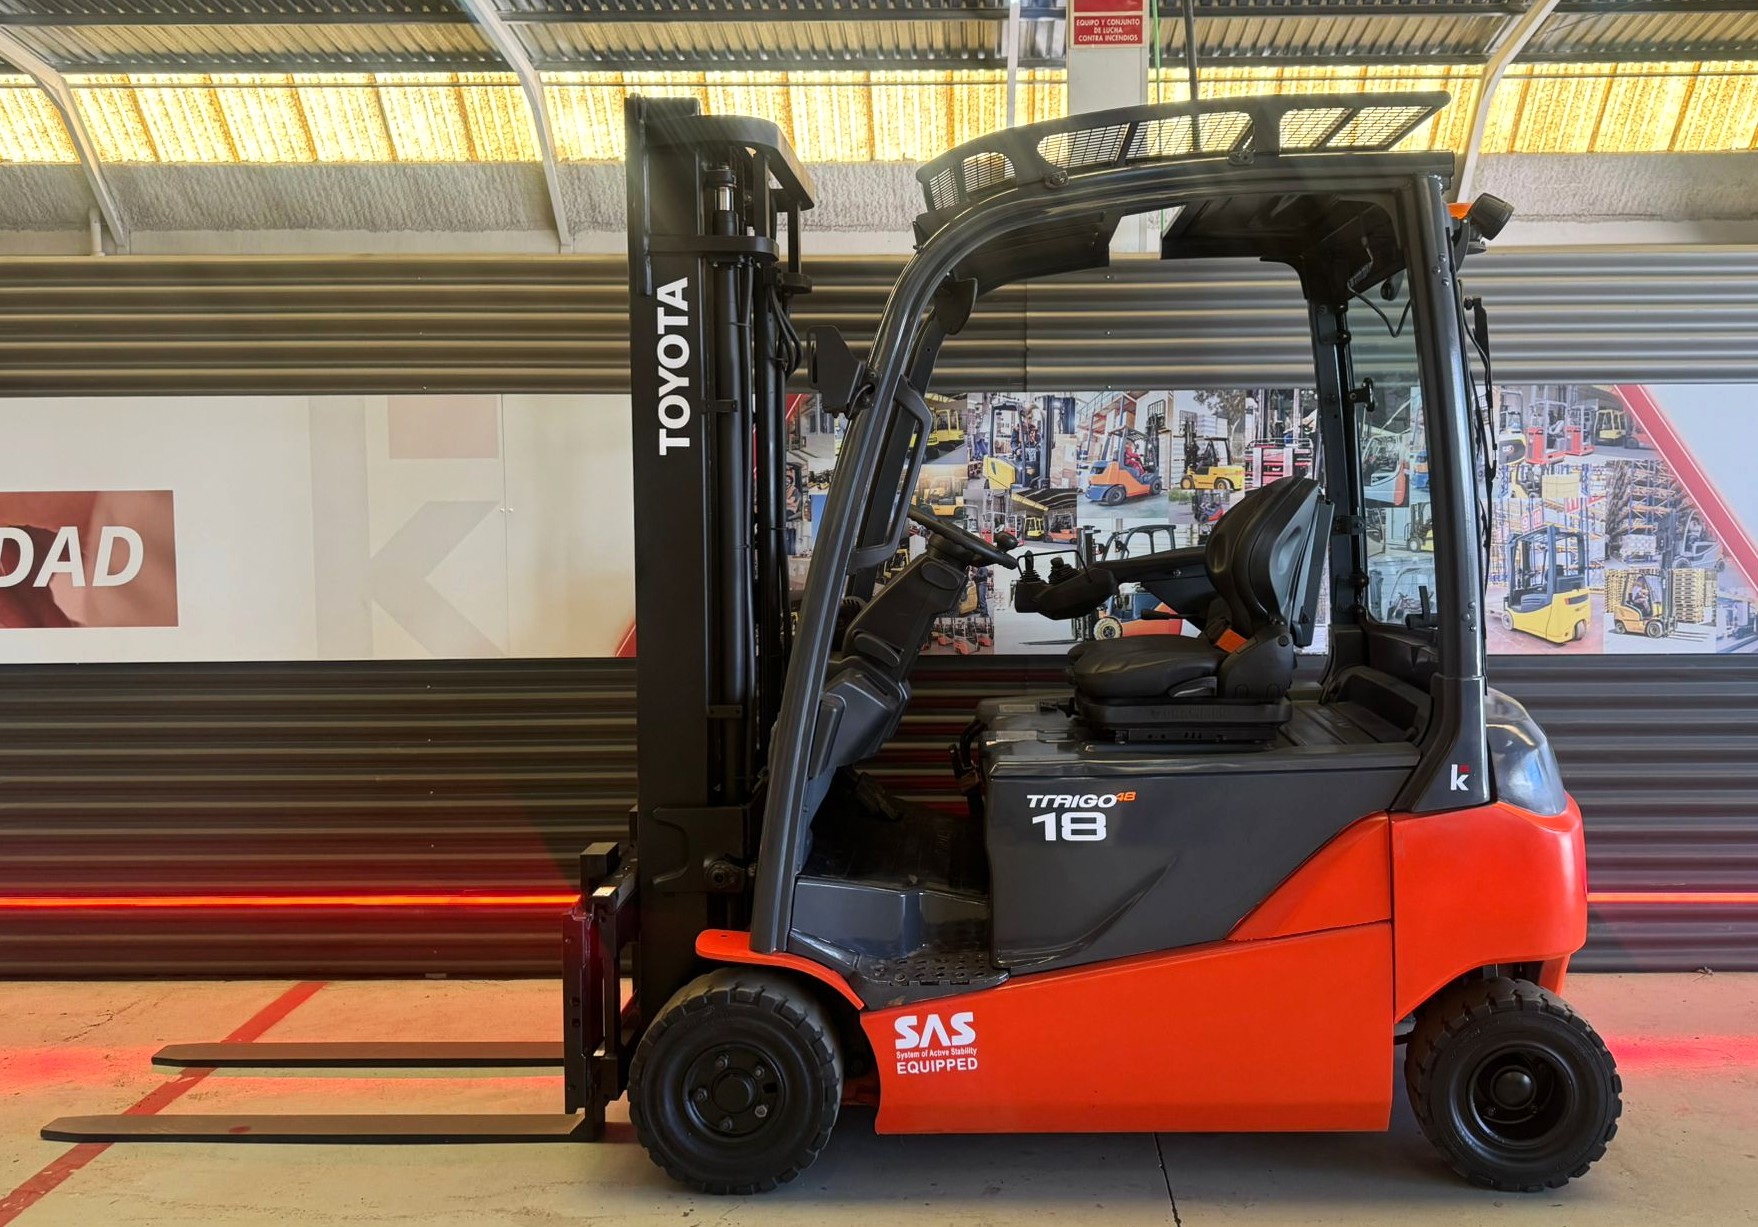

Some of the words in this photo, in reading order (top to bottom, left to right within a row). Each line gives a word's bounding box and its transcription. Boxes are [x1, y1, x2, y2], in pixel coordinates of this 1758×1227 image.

[657, 277, 690, 455] TOYOTA
[1032, 811, 1107, 841] 18
[894, 1012, 976, 1049] SAS
[896, 1051, 920, 1060] System
[929, 1049, 949, 1057] Active
[951, 1047, 977, 1056] Stability
[896, 1057, 978, 1074] EQUIPPED
